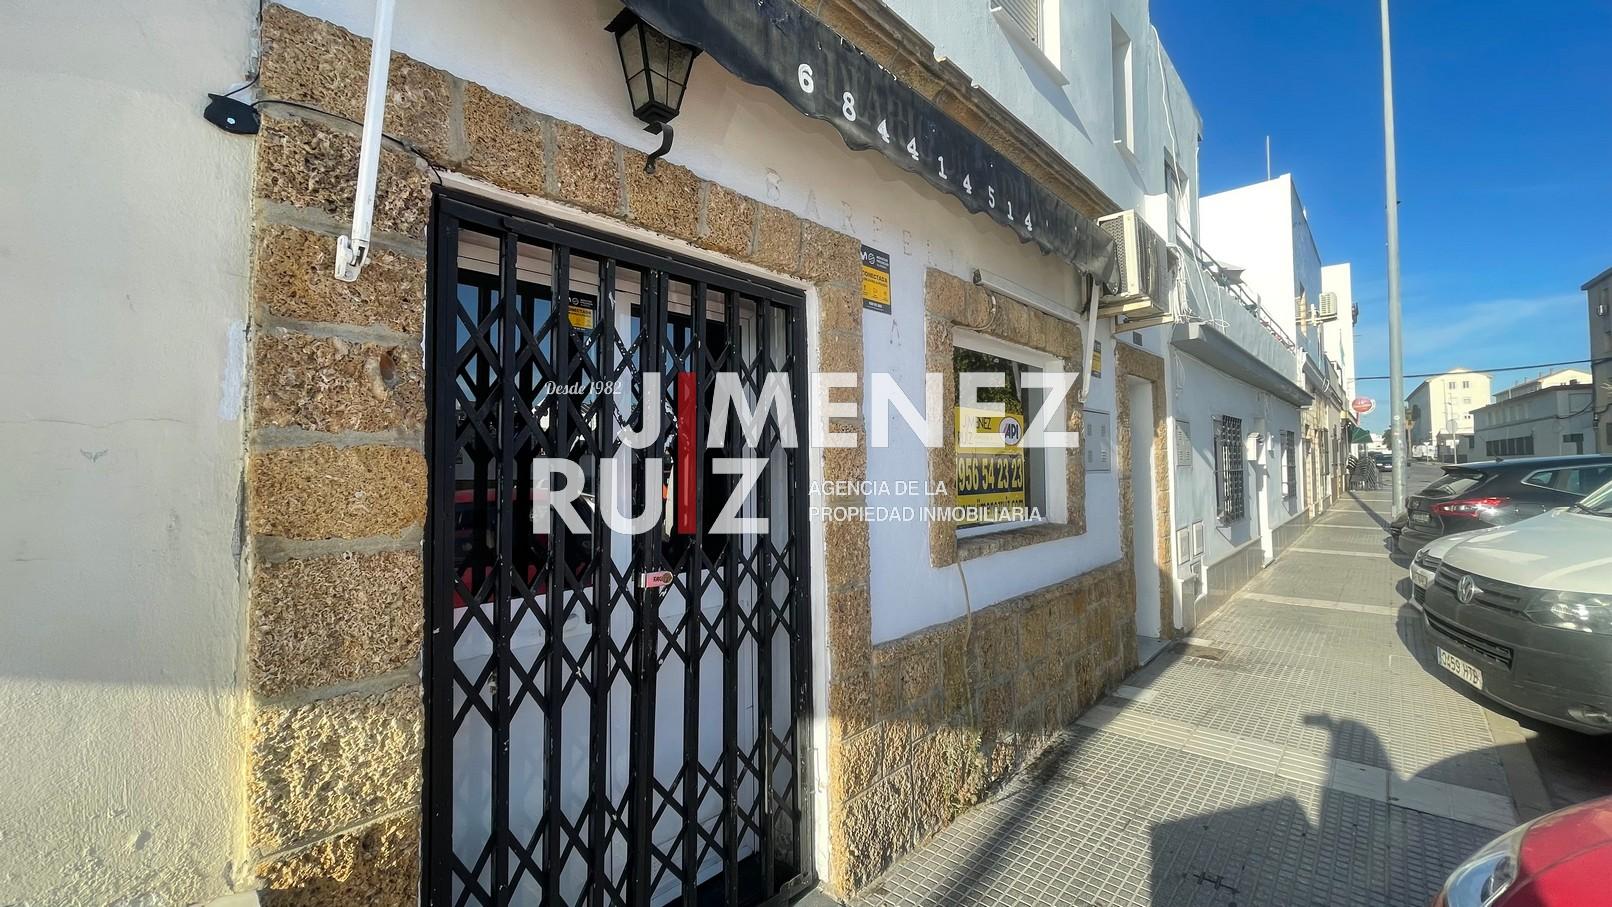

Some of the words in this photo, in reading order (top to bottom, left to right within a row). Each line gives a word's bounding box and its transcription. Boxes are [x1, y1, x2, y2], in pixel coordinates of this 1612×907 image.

[958, 457, 979, 491] 956
[982, 457, 994, 490] 54
[997, 457, 1009, 489] 23
[1011, 457, 1023, 488] 23
